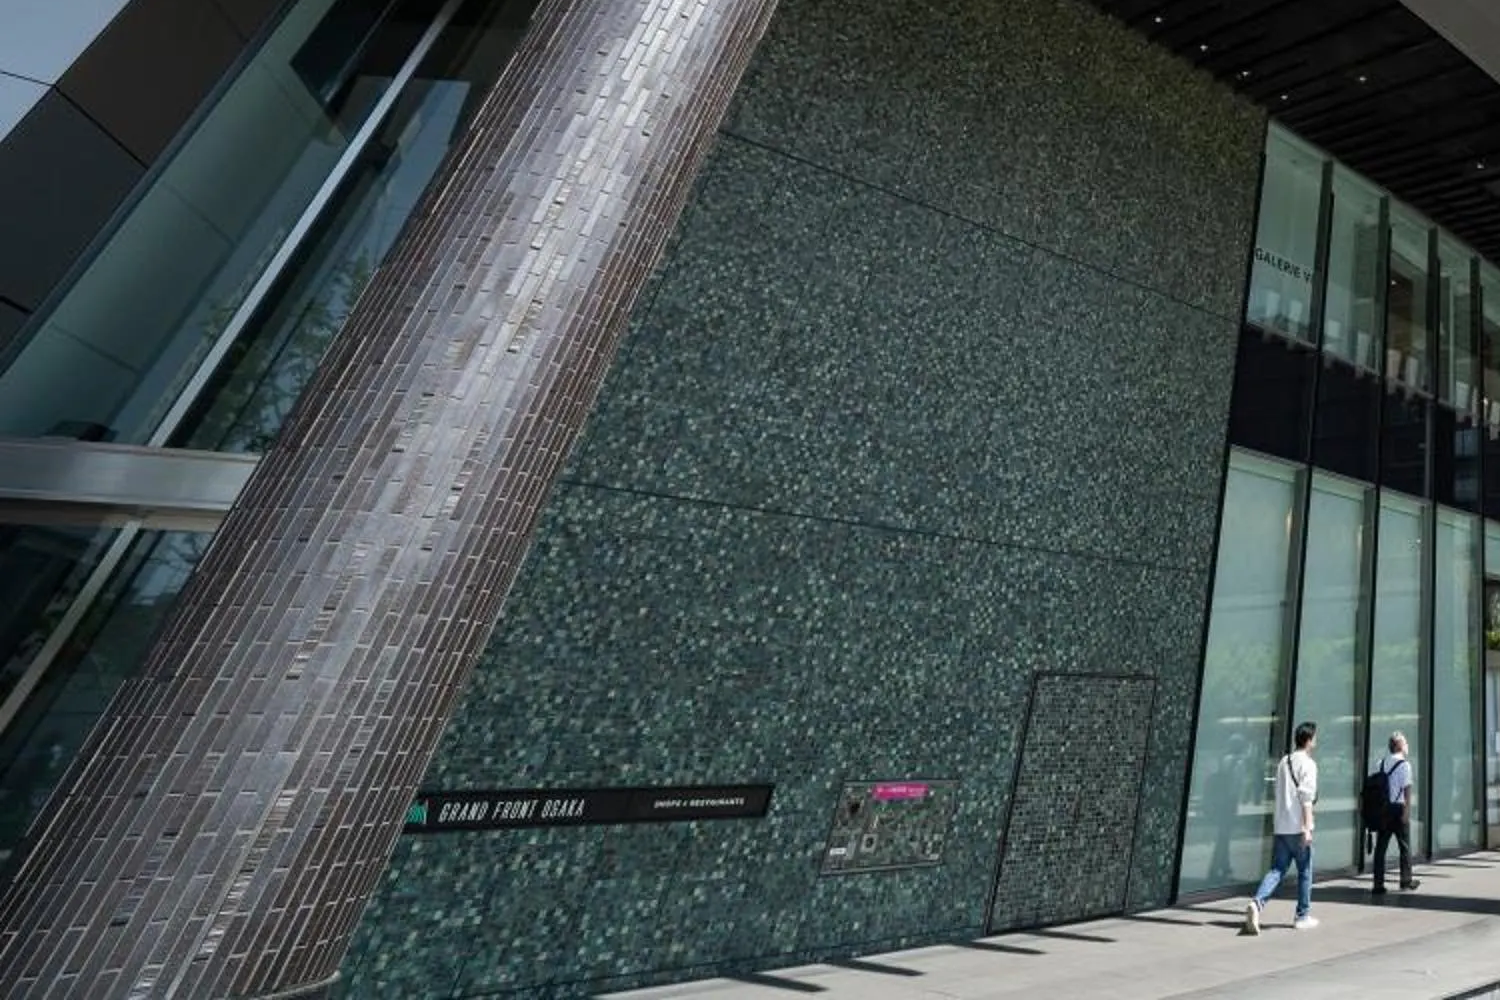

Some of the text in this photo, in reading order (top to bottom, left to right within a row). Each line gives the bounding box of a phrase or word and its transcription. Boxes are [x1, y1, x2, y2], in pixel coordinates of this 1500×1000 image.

[438, 802, 489, 823] GRAND
[491, 800, 539, 820] FRONT
[541, 799, 585, 819] OSAKA
